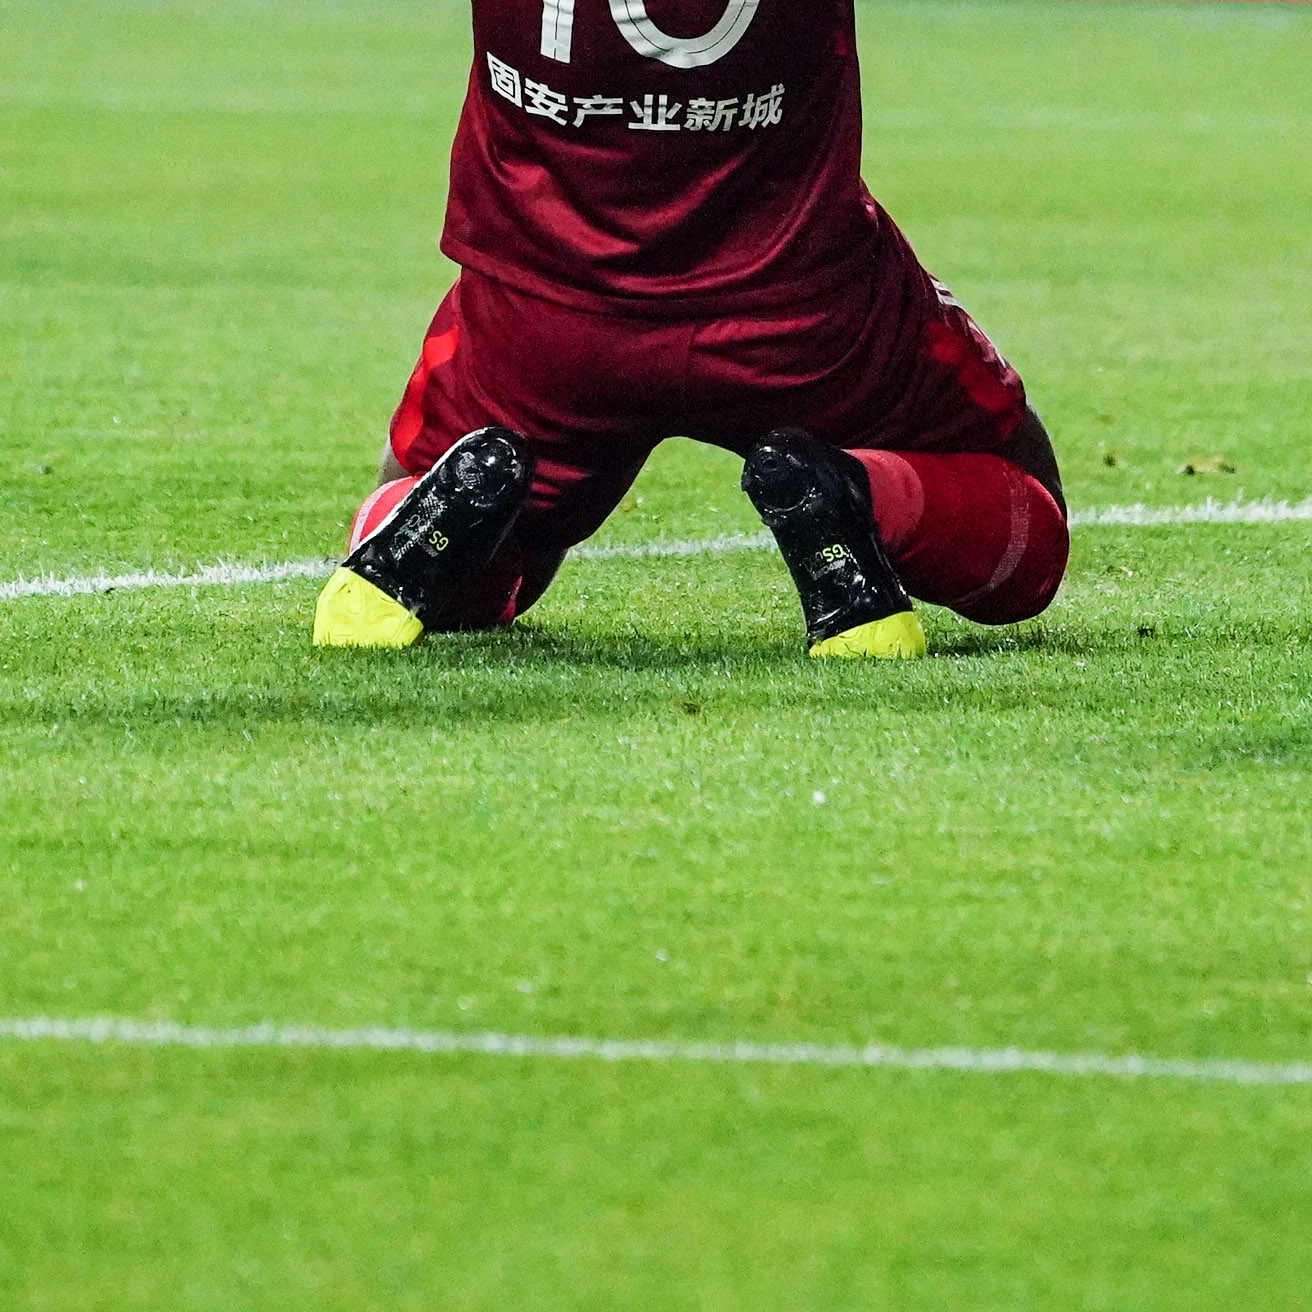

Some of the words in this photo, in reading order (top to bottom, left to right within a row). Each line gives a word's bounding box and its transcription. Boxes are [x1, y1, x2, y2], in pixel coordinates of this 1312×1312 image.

[486, 51, 785, 133] 固安产业新城
